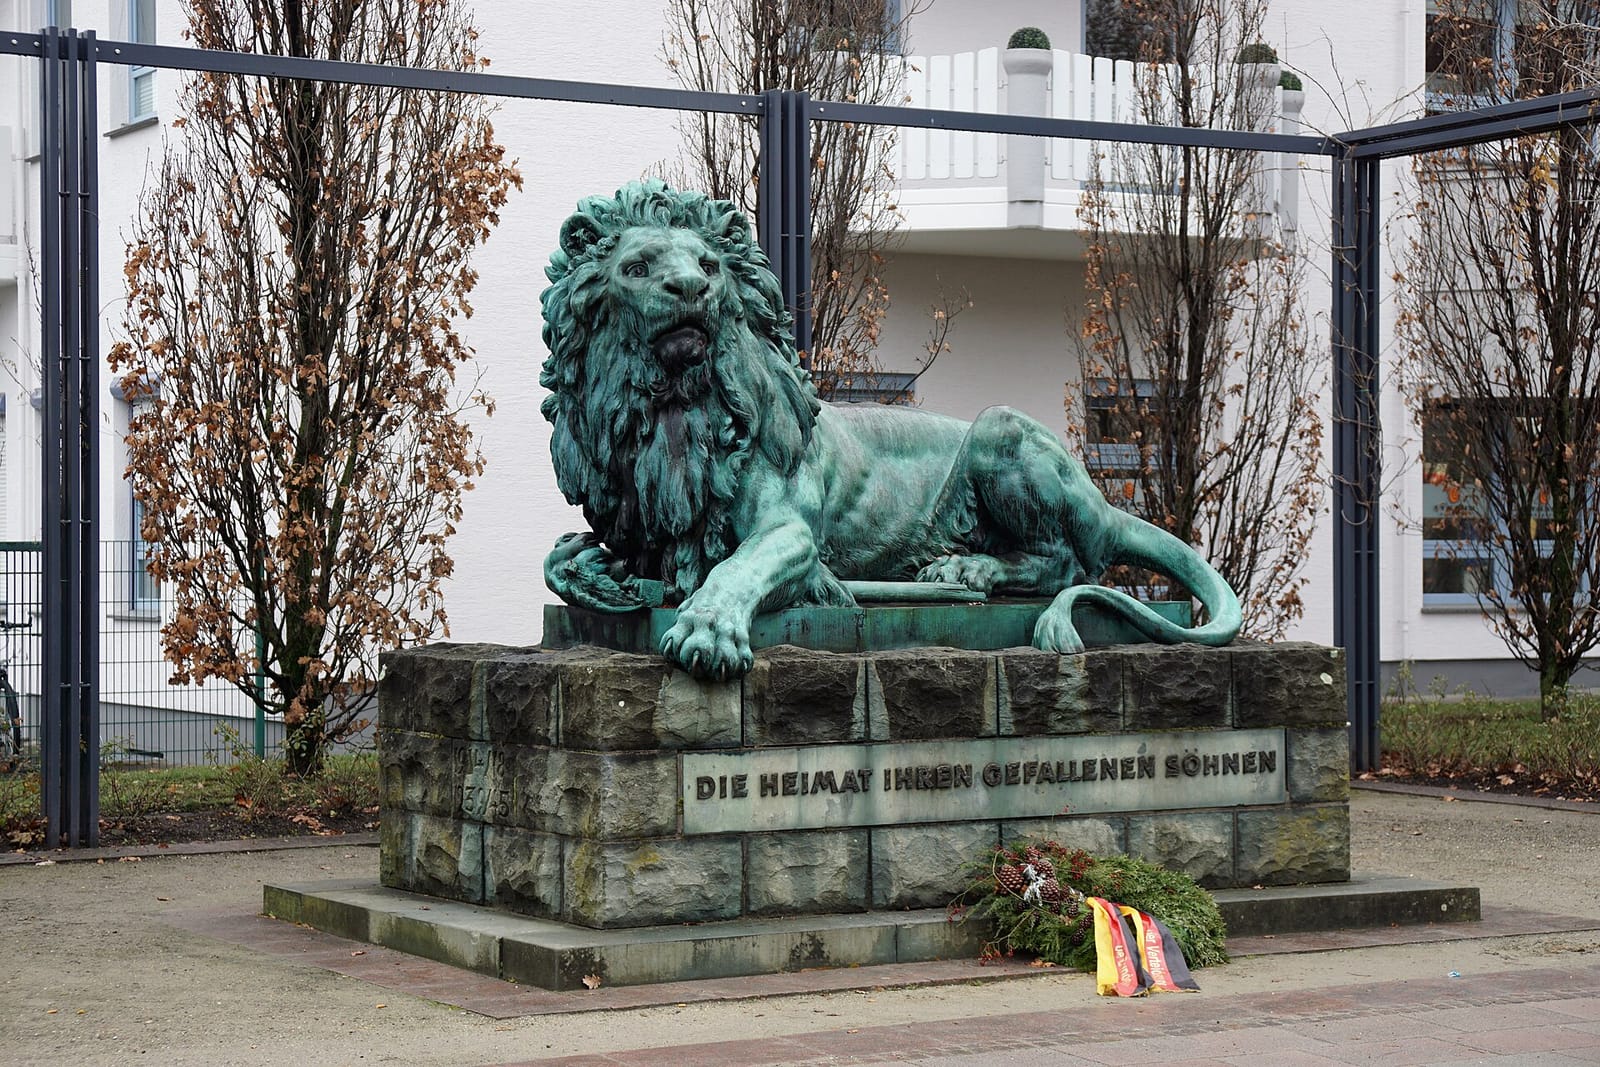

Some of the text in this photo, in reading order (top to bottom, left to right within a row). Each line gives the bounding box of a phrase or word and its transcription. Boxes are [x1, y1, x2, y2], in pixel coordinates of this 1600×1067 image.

[696, 748, 1276, 800] DIE HEIMAT IHREN GEFALLENEN SÖHNEN
